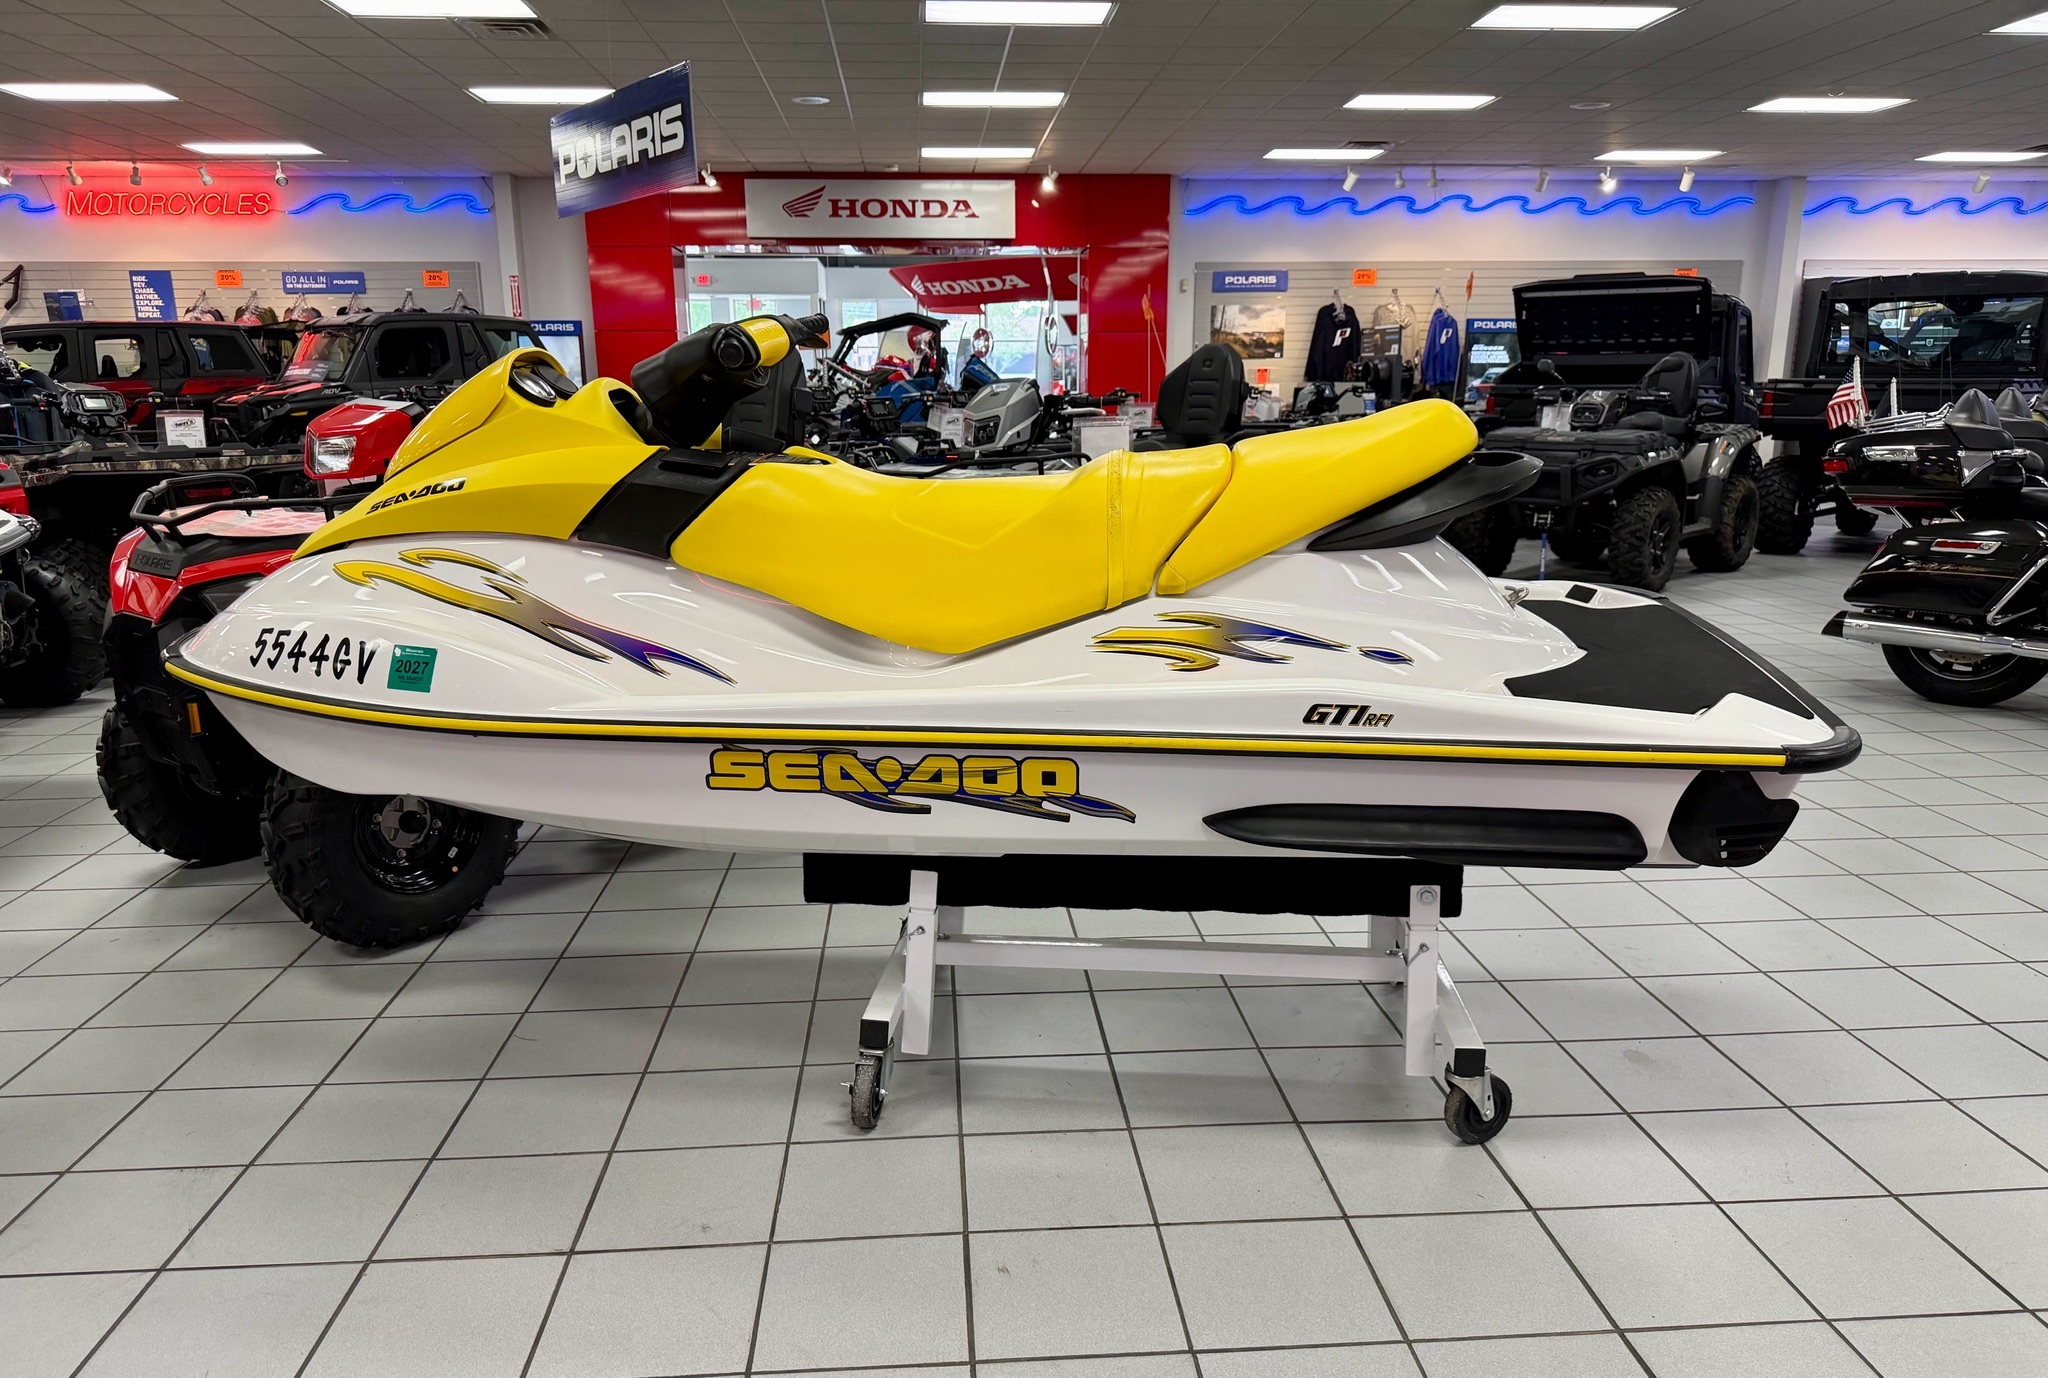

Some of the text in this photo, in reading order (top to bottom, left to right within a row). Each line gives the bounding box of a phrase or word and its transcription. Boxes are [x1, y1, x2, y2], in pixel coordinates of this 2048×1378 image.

[558, 103, 685, 186] POLARIS
[66, 190, 271, 216] MOTORCYCLES
[828, 198, 980, 219] HONDA
[285, 275, 326, 283] GO ALL IN
[925, 274, 1030, 296] HONDA
[1225, 275, 1277, 285] POLARIS
[530, 323, 574, 332] OLARIS
[1474, 321, 1517, 329] POLARI
[250, 627, 381, 685] 5544GV
[395, 659, 430, 675] 2027
[1302, 703, 1395, 728] GTI RFI
